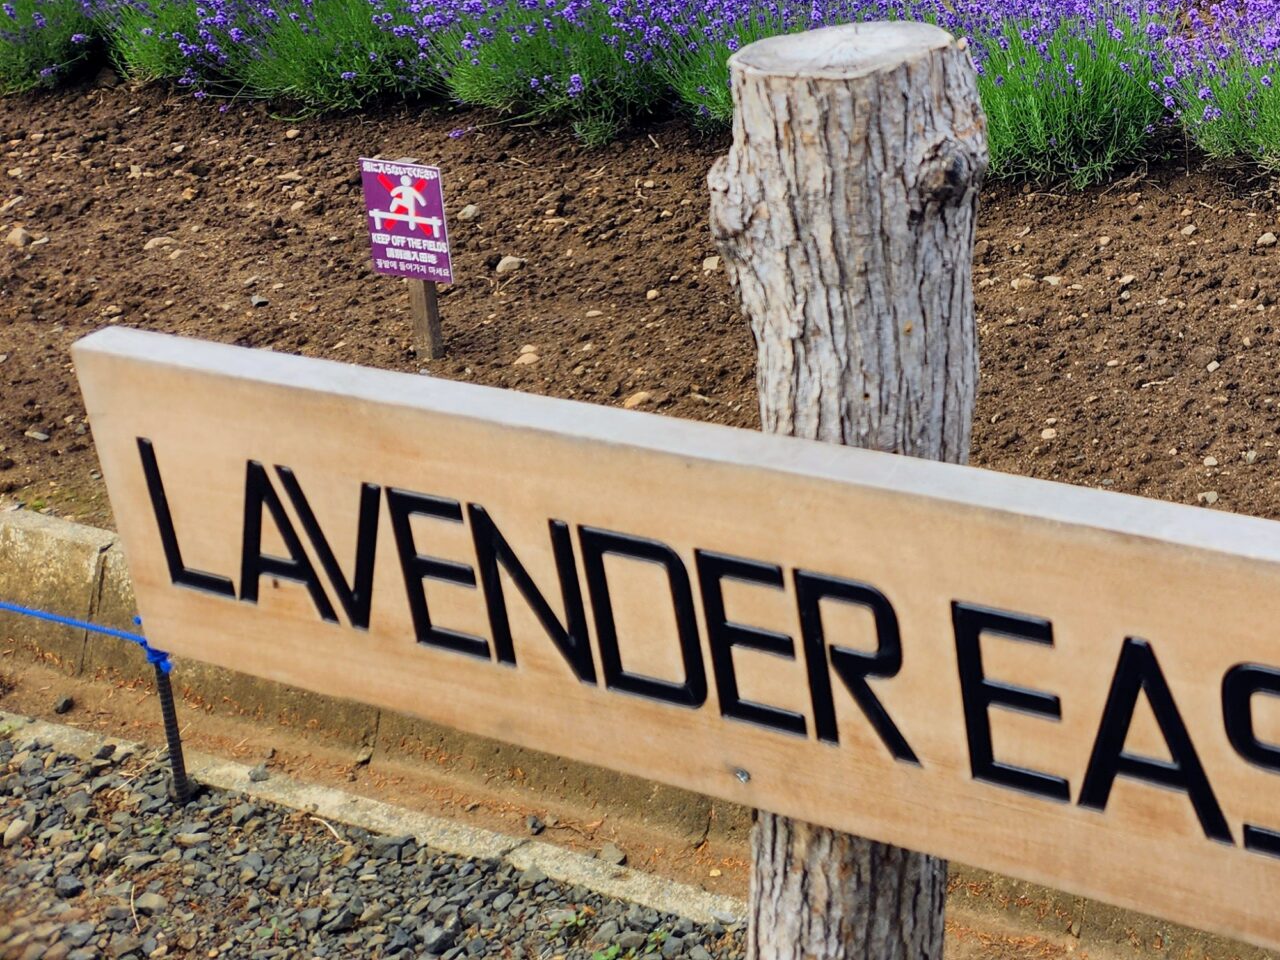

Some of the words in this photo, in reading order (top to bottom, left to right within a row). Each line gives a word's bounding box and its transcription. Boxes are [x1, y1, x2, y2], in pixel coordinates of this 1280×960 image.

[371, 233, 390, 245] KEEP
[391, 235, 406, 247] OFF
[406, 237, 423, 249] THE
[422, 240, 448, 253] FIELDS
[398, 262, 426, 273] 들어가지
[428, 266, 450, 277] 마세요
[135, 437, 922, 767] LAVENDER
